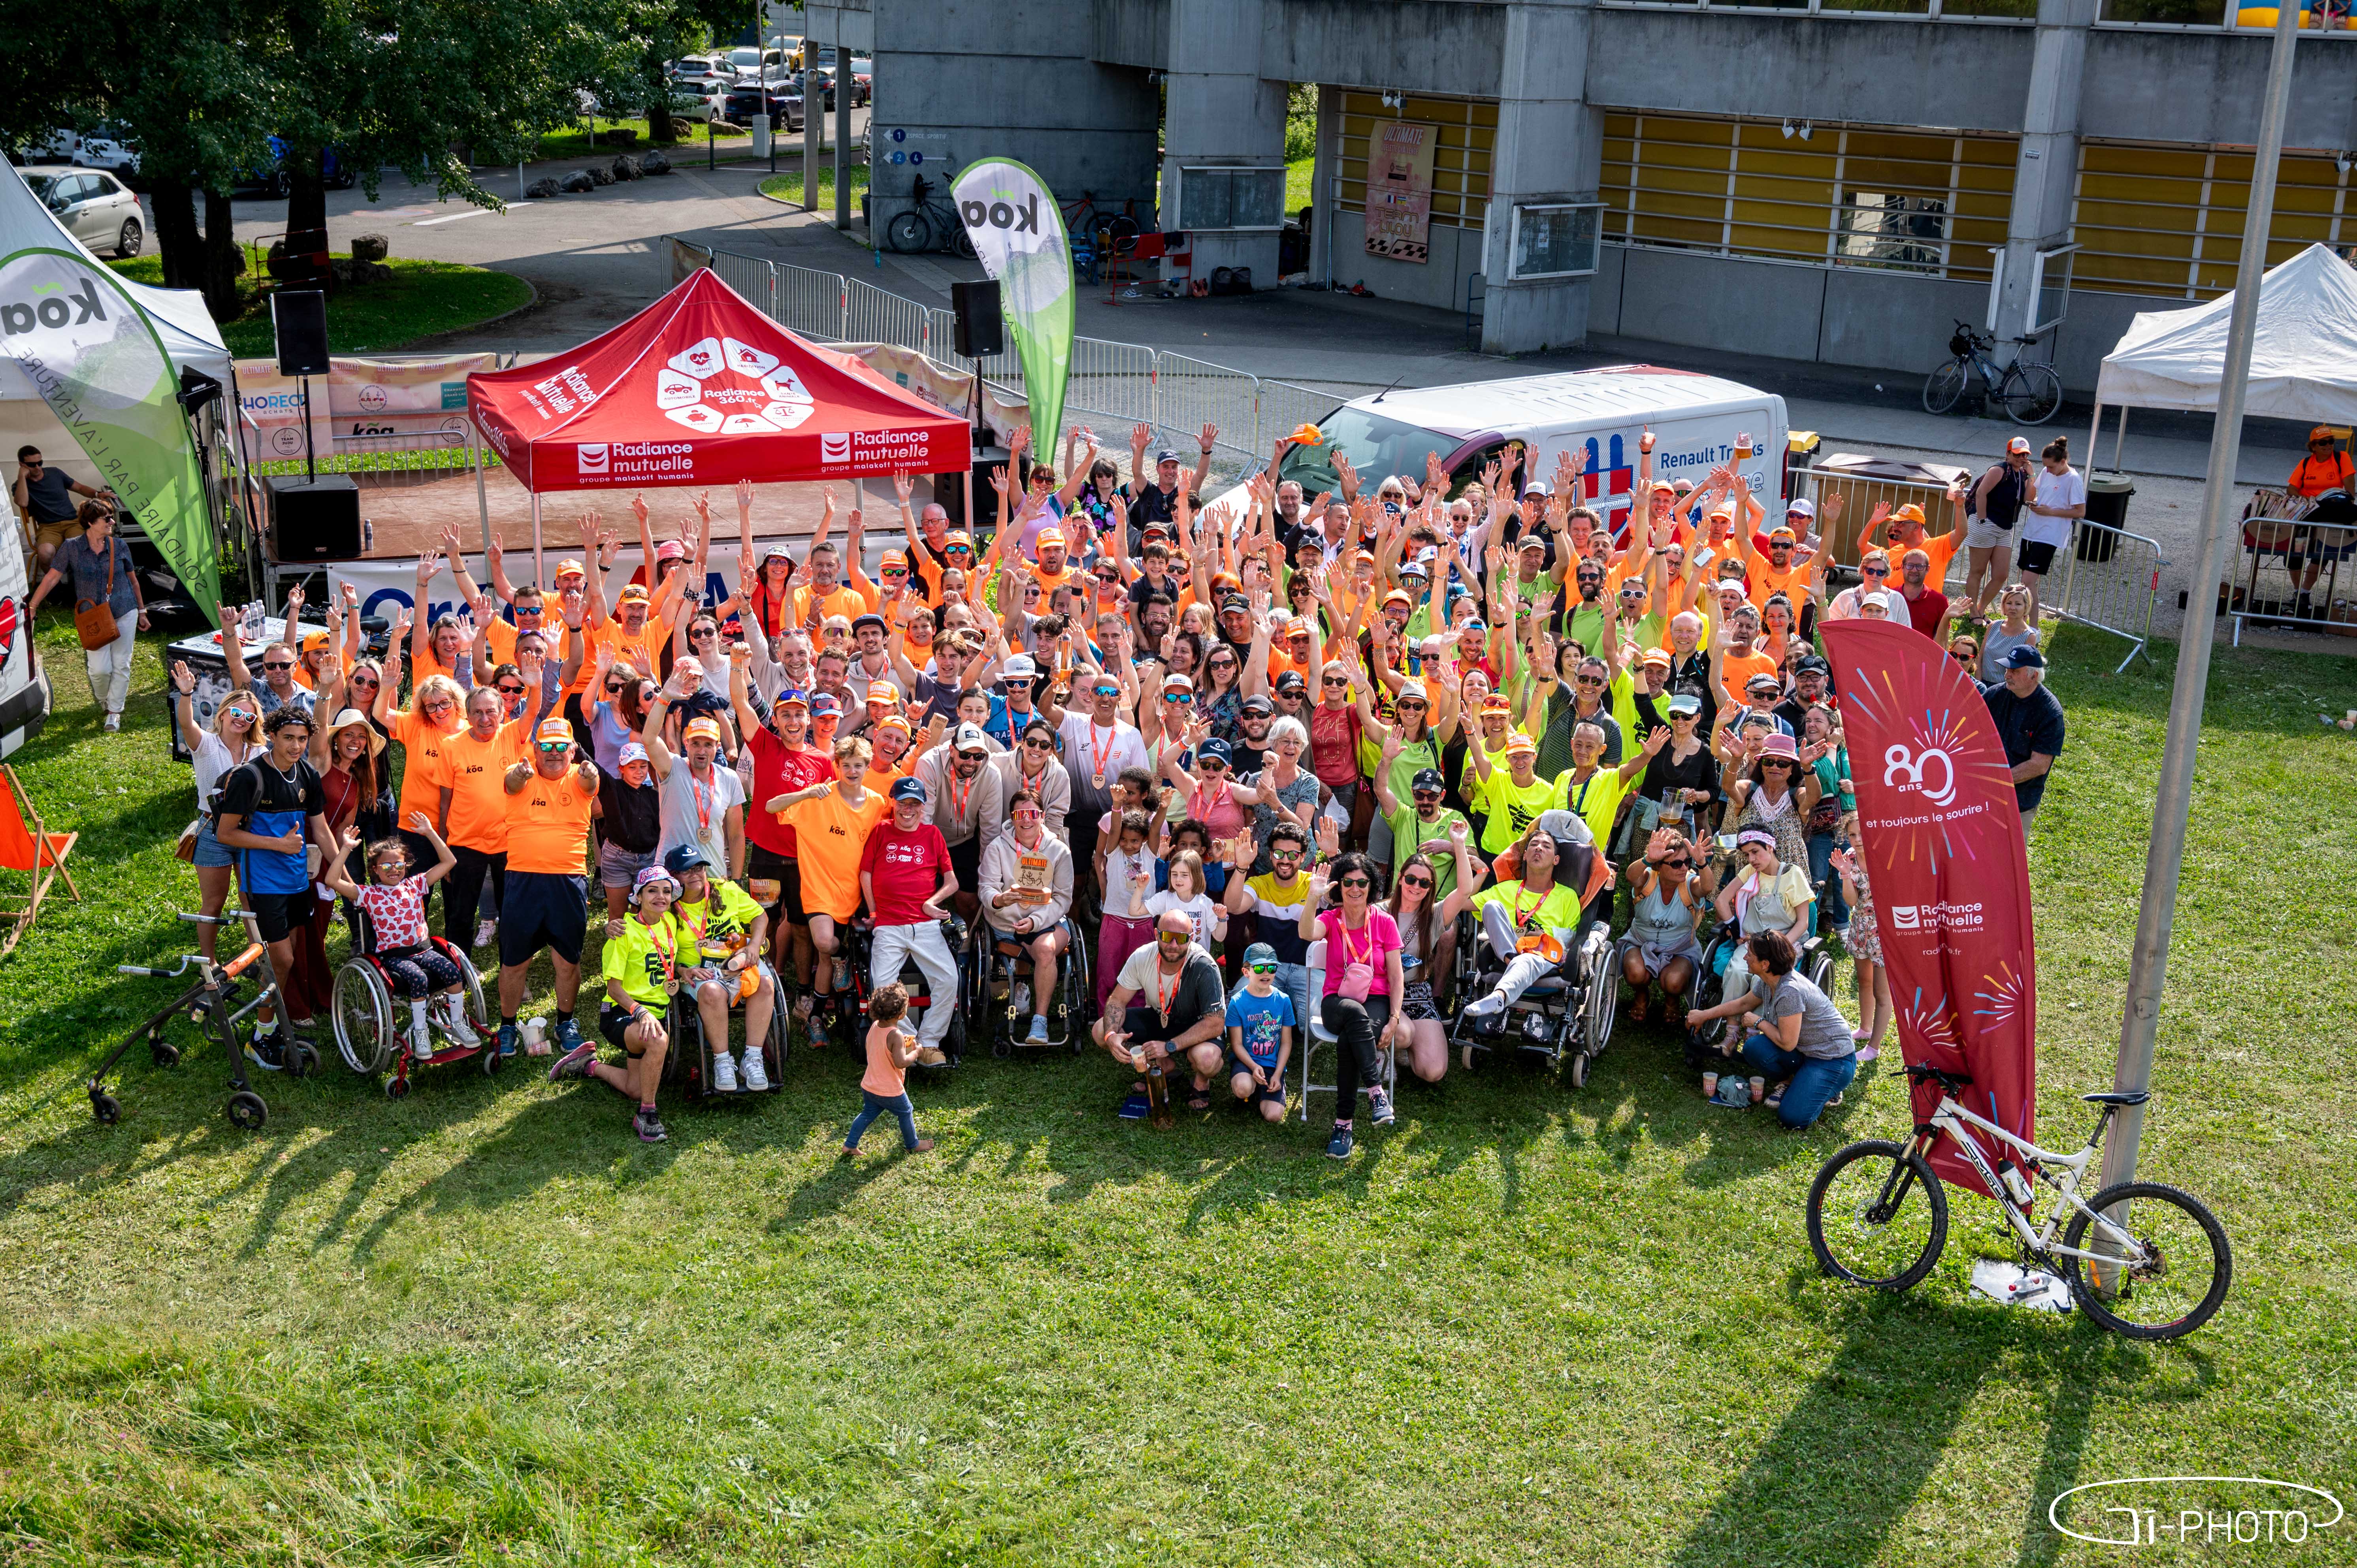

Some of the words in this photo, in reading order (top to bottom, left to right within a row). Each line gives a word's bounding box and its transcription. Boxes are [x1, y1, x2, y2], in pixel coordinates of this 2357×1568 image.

[1384, 126, 1423, 145] ULTIMATE
[1375, 206, 1419, 224] TEAM
[1380, 220, 1412, 237] LILOU
[332, 363, 360, 371] ULTIMATE
[457, 359, 483, 367] ULTIMATE
[242, 366, 271, 375] ULTIMATE
[704, 388, 765, 398] Radiance
[719, 396, 756, 404] 360.fr
[854, 431, 929, 445] Radiance
[613, 442, 693, 456] Radiance
[855, 444, 928, 461] mutuelle
[1660, 447, 1714, 469] Renault
[1718, 443, 1764, 461] Trks
[614, 456, 693, 472] mutuelle
[869, 685, 892, 695] ULTIMATE
[543, 721, 569, 731] ULTIMATE
[1884, 744, 1954, 800] 80
[1899, 783, 1922, 792] ans
[1866, 819, 1878, 828] et
[1881, 816, 1928, 827] toujours
[1932, 813, 1943, 822] le
[1946, 805, 1982, 820] sourire
[1986, 802, 1989, 811] !
[1021, 858, 1047, 868] ULTIMATE
[1921, 900, 1982, 915] Radiance
[1252, 1041, 1276, 1056] CITY
